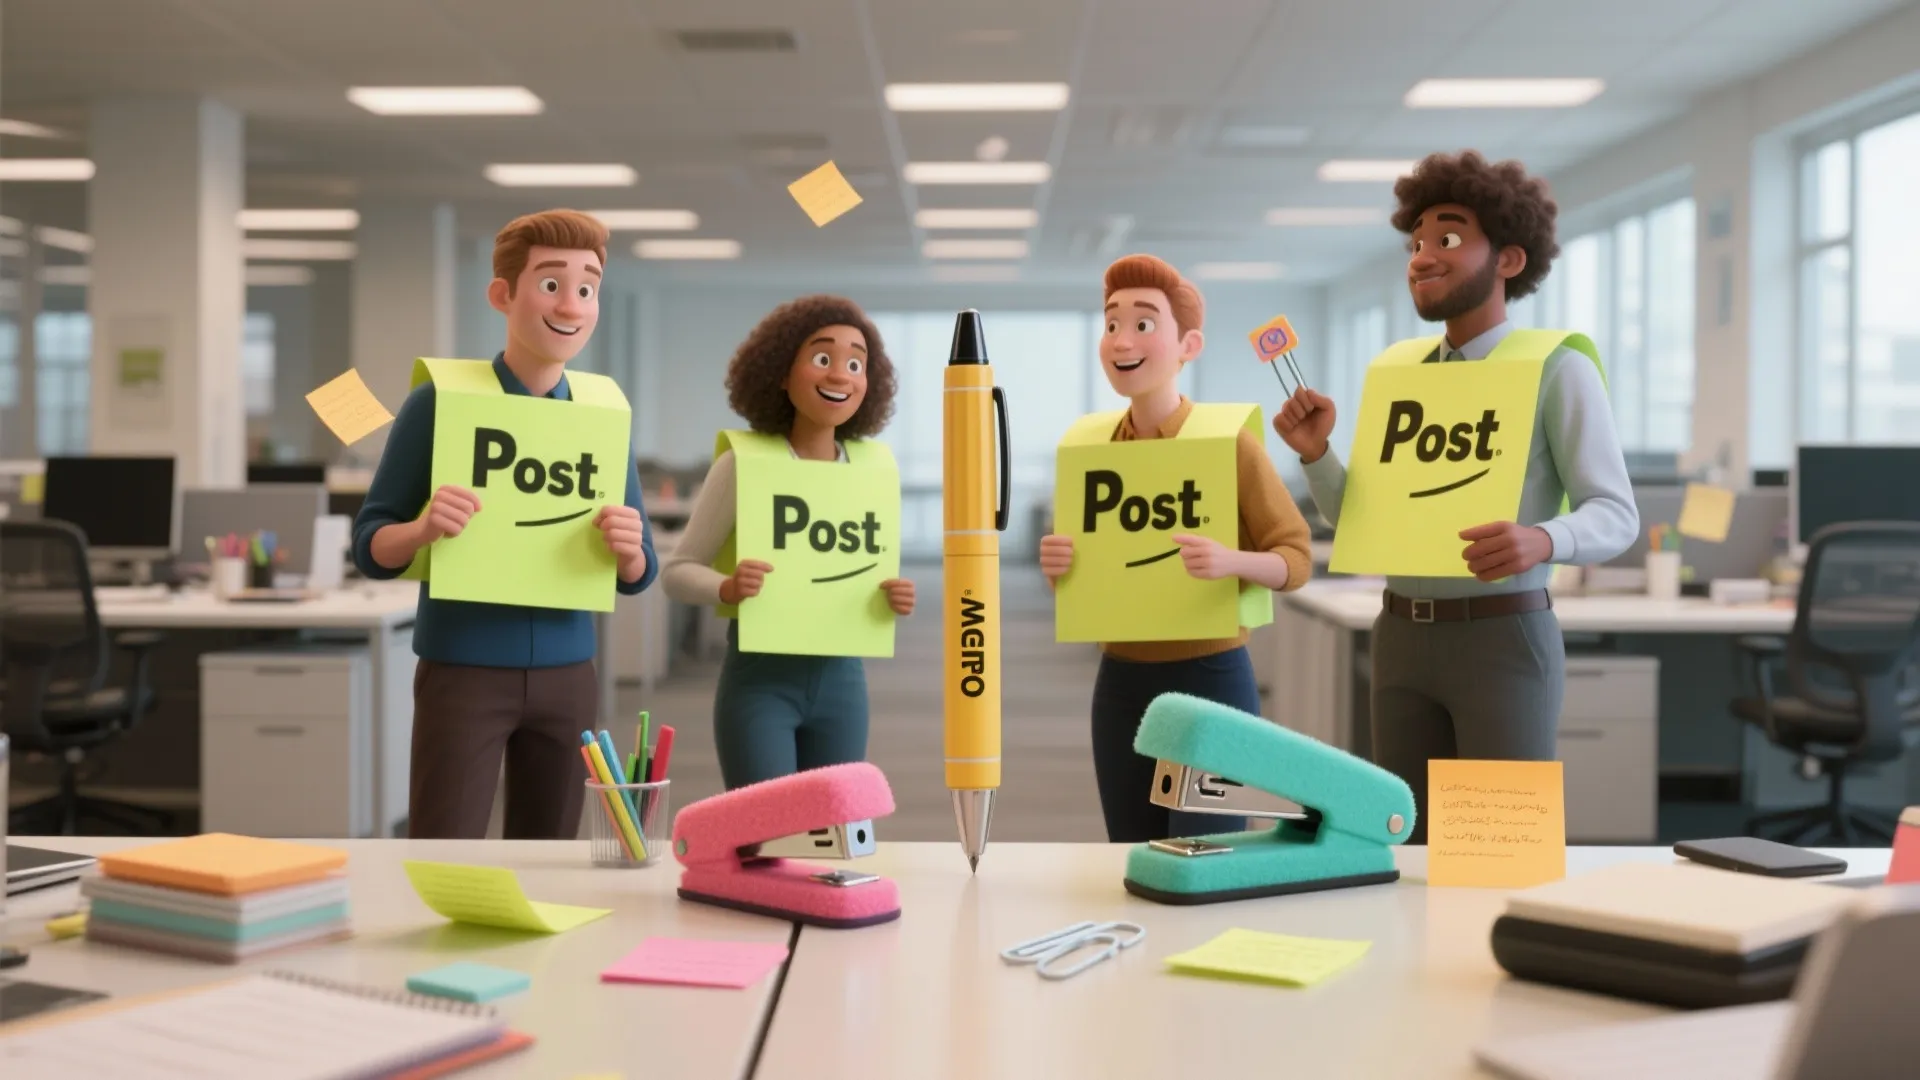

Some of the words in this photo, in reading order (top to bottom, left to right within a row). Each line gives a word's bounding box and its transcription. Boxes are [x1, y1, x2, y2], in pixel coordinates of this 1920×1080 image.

[1380, 400, 1500, 463] Post
[472, 427, 598, 500] Post
[773, 494, 881, 554] Post
[1083, 469, 1202, 533] Post
